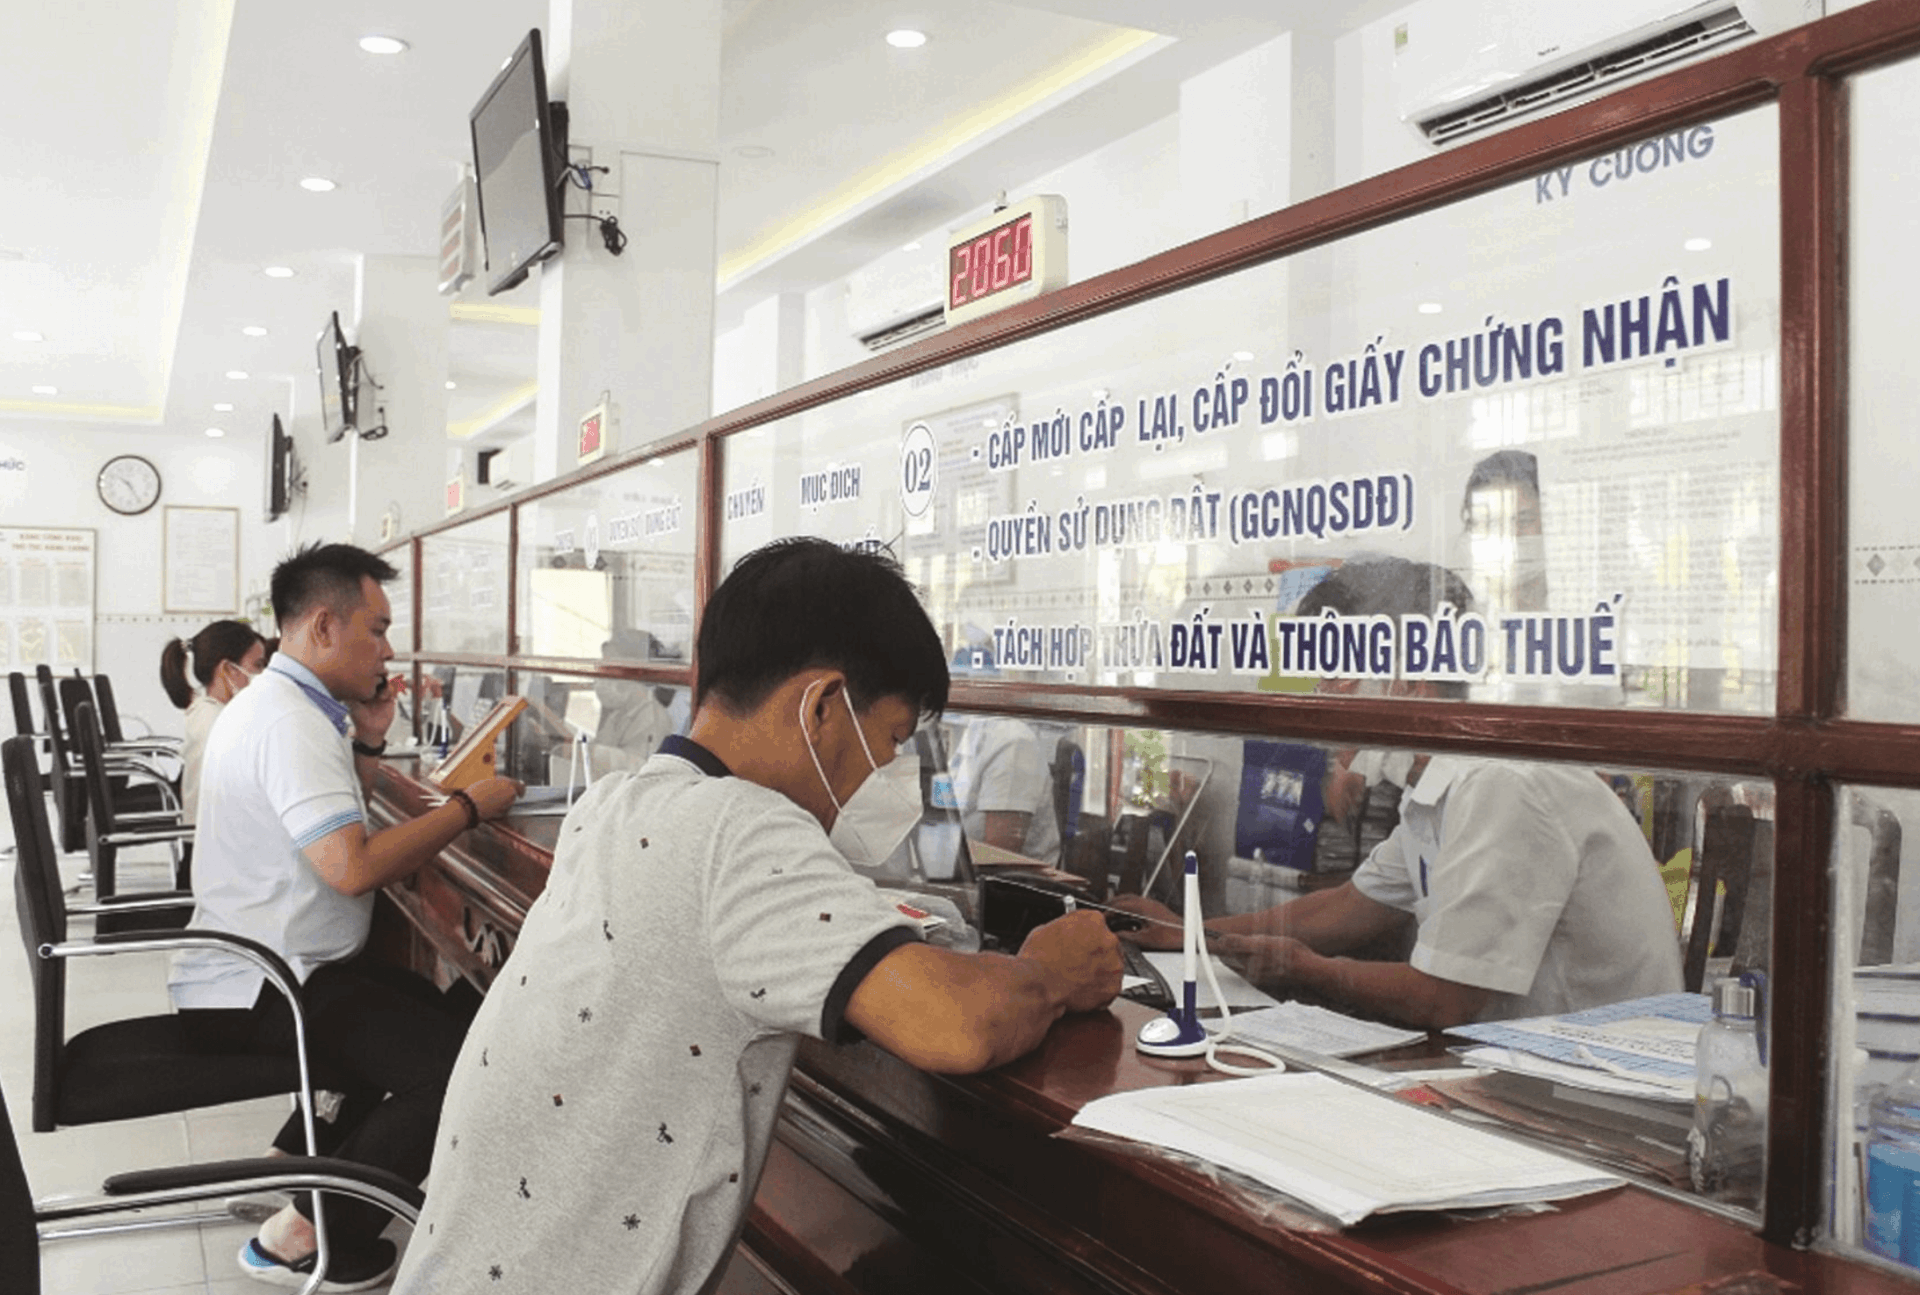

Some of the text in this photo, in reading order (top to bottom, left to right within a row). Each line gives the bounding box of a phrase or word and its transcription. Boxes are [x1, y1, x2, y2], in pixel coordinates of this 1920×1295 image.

[953, 218, 1033, 305] 2060
[988, 413, 1025, 469] CẤP
[1031, 407, 1070, 461] MỚI
[1079, 388, 1125, 452] CẤP
[1139, 394, 1184, 451] LẠI,
[1193, 363, 1249, 433] CẤP
[1259, 350, 1311, 425] ĐỔI
[1325, 335, 1405, 413] GIẤY
[1419, 315, 1563, 397] CHỨNG
[1583, 275, 1730, 369] NHẬN
[801, 473, 828, 513] MỤC
[905, 448, 932, 494] 02
[989, 500, 1051, 560] QUYỀN
[1058, 496, 1090, 551] SỬ
[1095, 501, 1161, 557] DỤNG
[1230, 474, 1413, 545] (GCNQSDĐ)
[994, 593, 1622, 680] TÁCH HỢP THỬA ĐẤT VÀ THÔNG BÁO THUẾ
